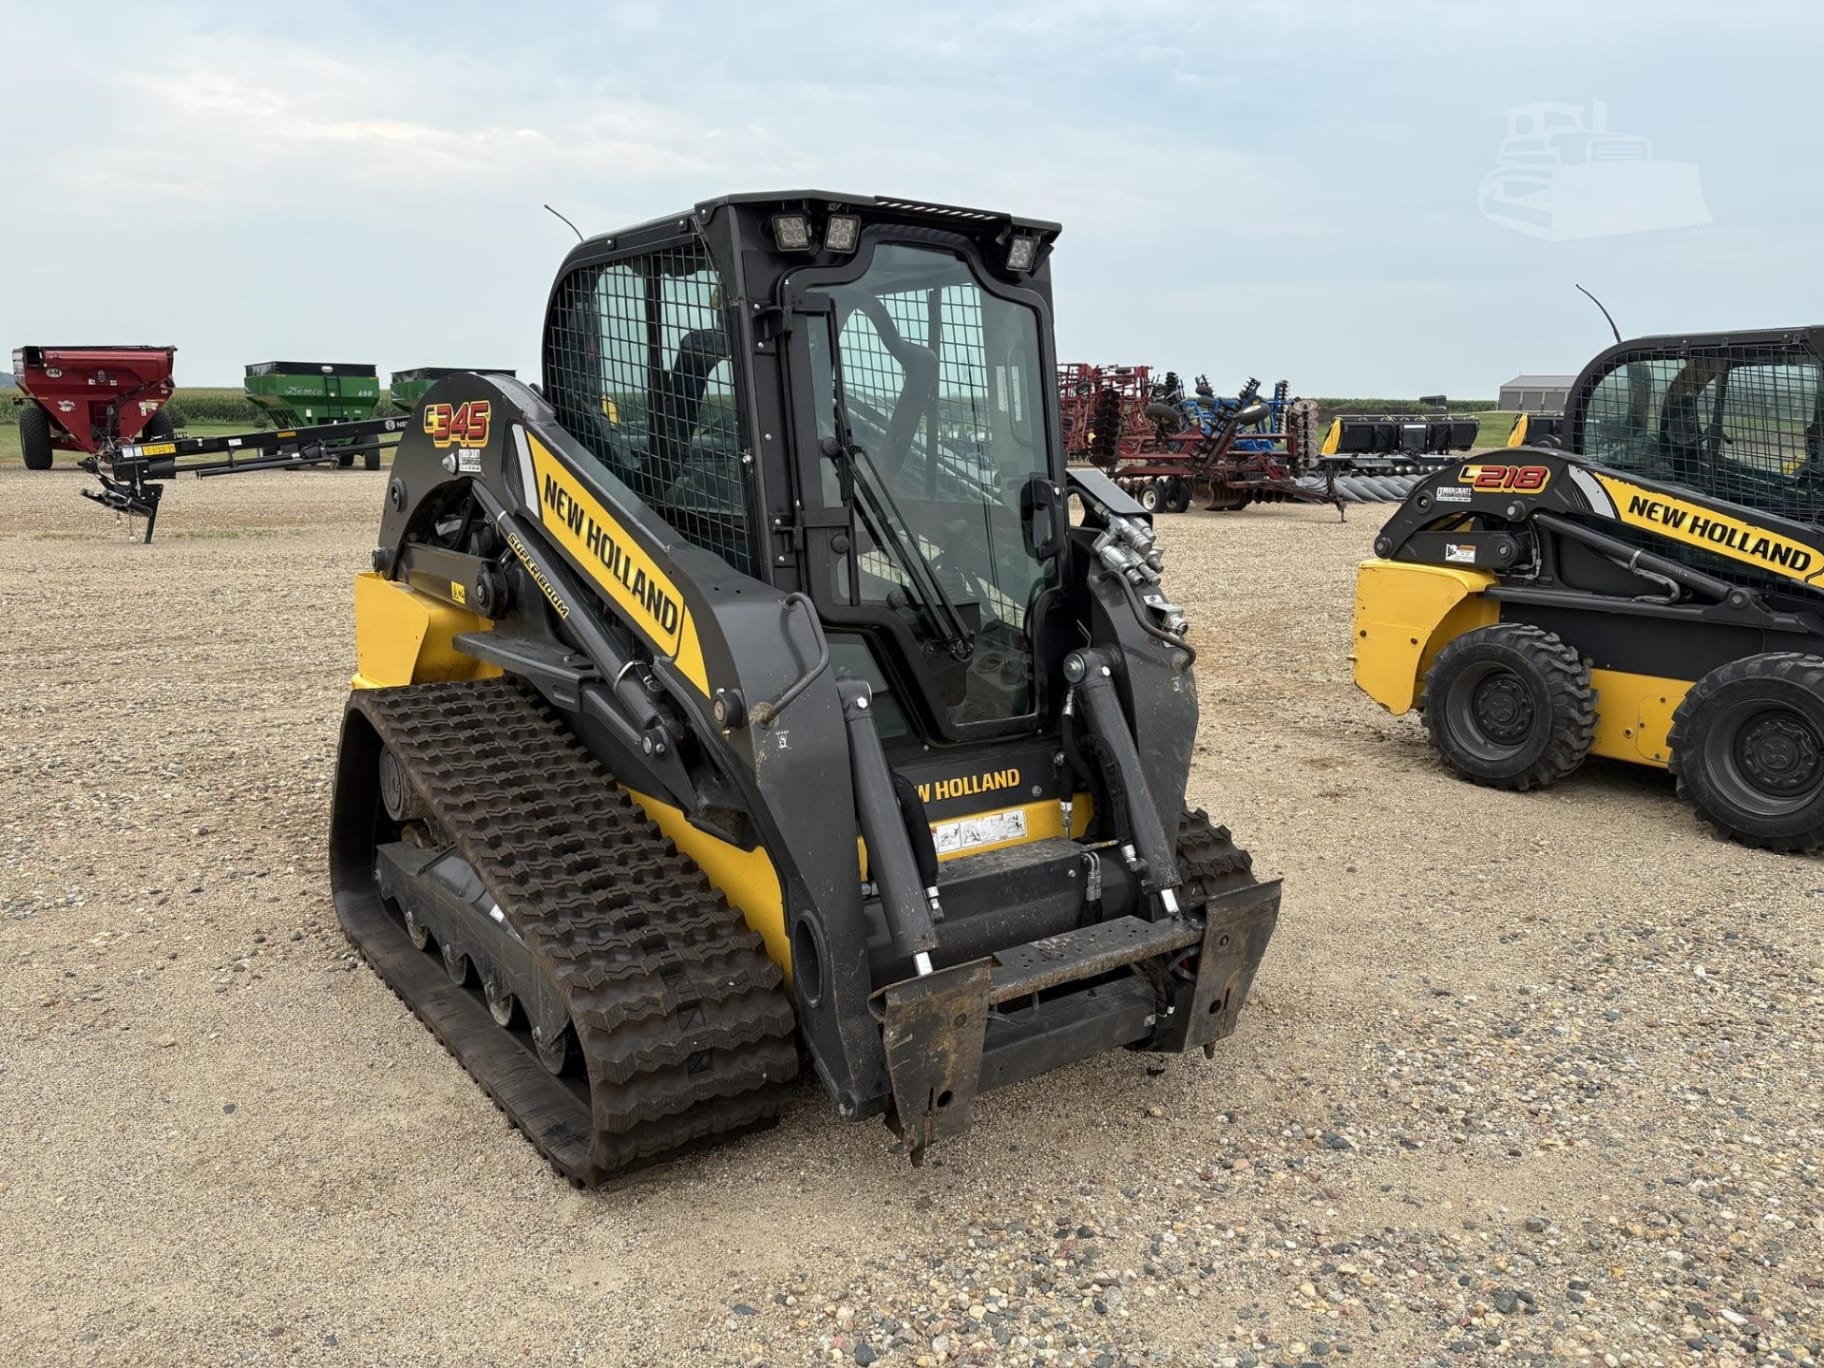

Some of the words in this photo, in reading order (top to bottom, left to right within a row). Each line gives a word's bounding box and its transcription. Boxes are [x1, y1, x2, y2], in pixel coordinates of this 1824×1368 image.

[1458, 464, 1551, 494] L218
[544, 473, 585, 536] NEW
[586, 517, 678, 635] HOLLAND
[1628, 495, 1688, 529] NEW
[1688, 515, 1812, 572] HOLLAND
[935, 768, 1020, 801] HOLLAND
